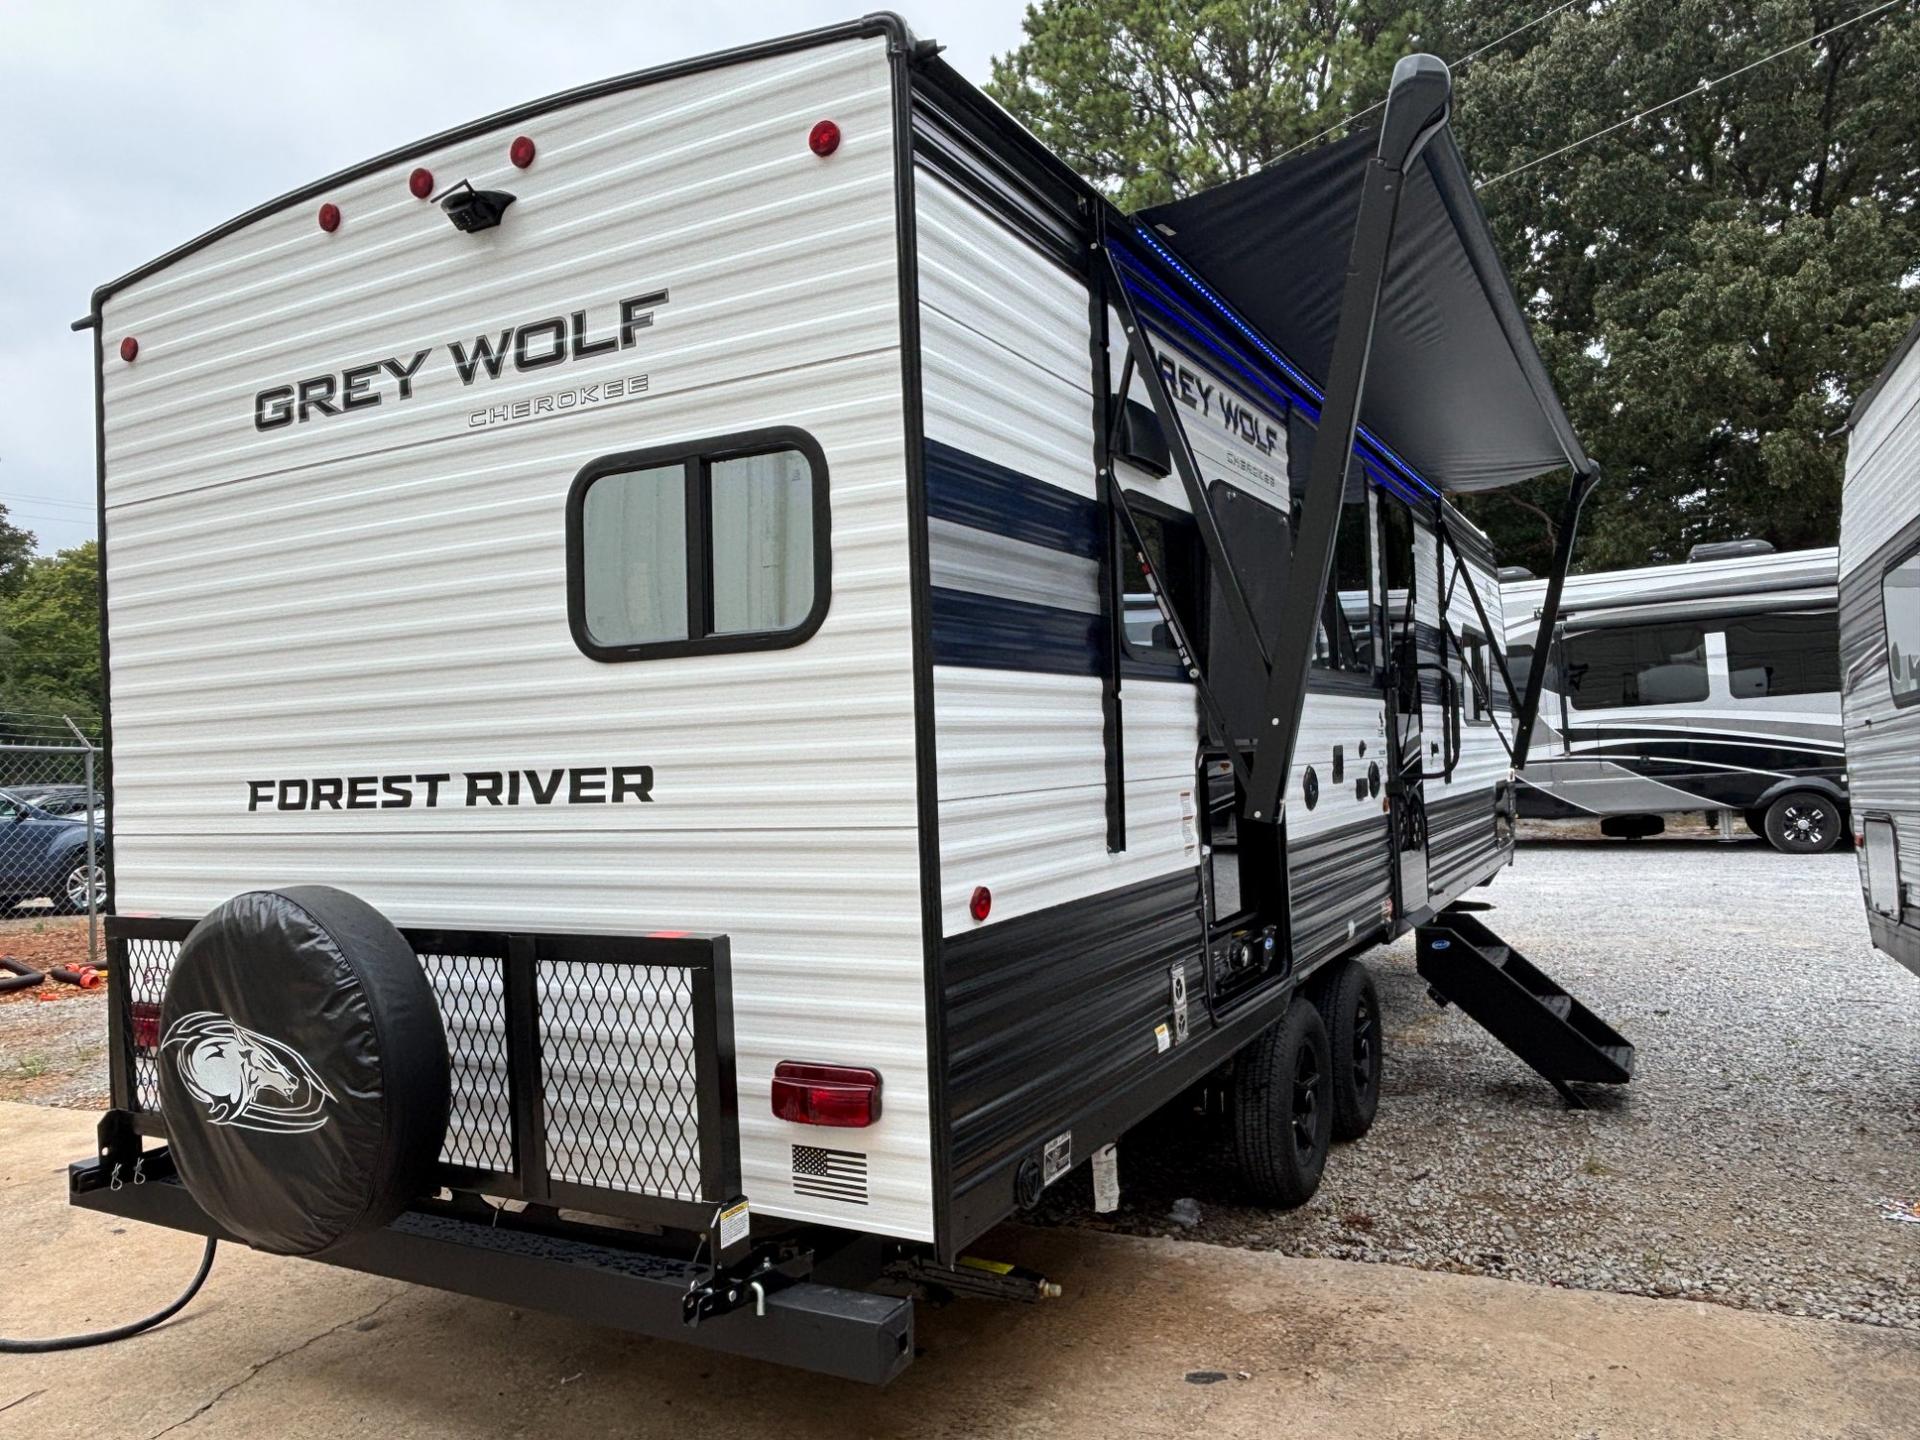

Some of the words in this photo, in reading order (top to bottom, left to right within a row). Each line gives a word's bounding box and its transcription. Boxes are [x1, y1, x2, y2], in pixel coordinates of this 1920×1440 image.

[254, 347, 432, 432] GREY
[446, 288, 670, 386] WOLF
[468, 374, 649, 428] CHEROKEE
[1157, 351, 1215, 417] REY
[1219, 391, 1277, 456] WOLF
[246, 773, 450, 811] FOREST
[463, 765, 655, 807] RIVER
